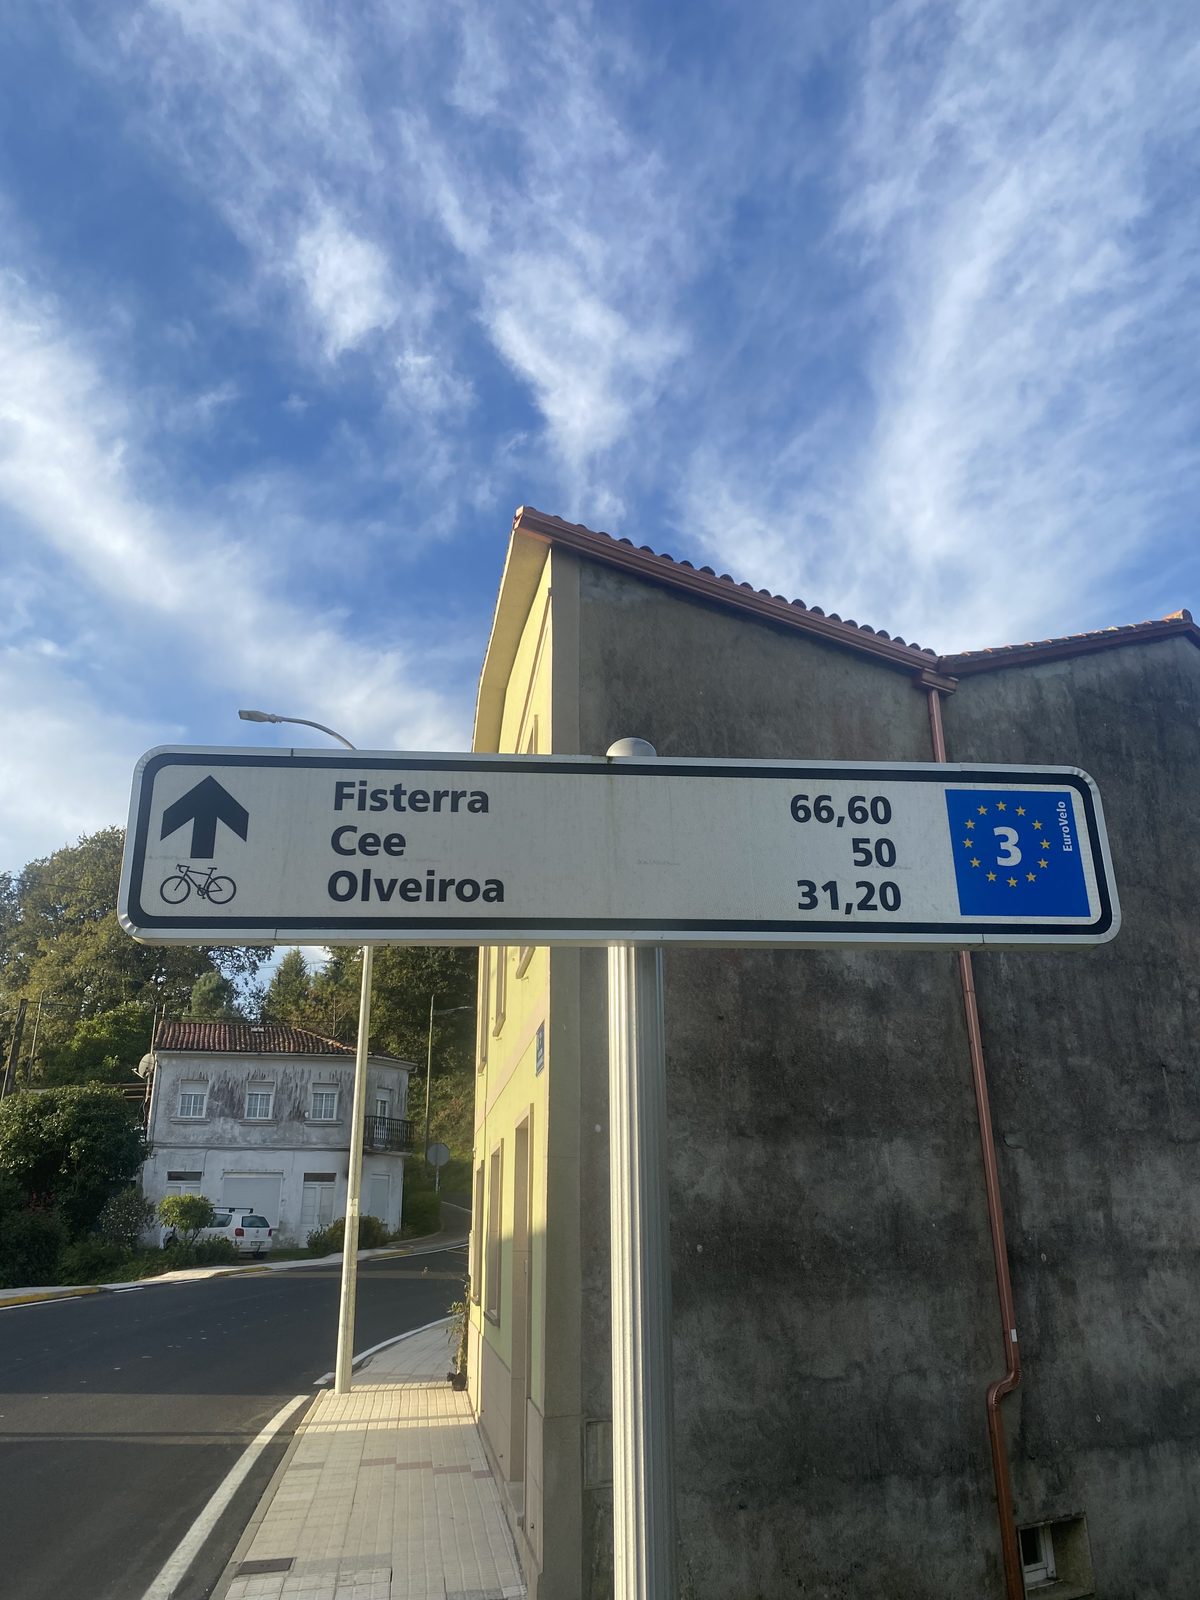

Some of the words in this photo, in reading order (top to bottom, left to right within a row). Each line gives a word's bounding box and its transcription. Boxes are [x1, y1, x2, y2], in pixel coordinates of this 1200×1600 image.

[333, 780, 489, 814] Fisterra
[790, 794, 892, 828] 66,60
[330, 825, 406, 857] Cee
[1057, 801, 1073, 852] EuroVelo
[851, 837, 897, 868] 50
[993, 826, 1023, 867] 3
[327, 869, 505, 903] Olveiroa
[796, 879, 902, 915] 31,20
